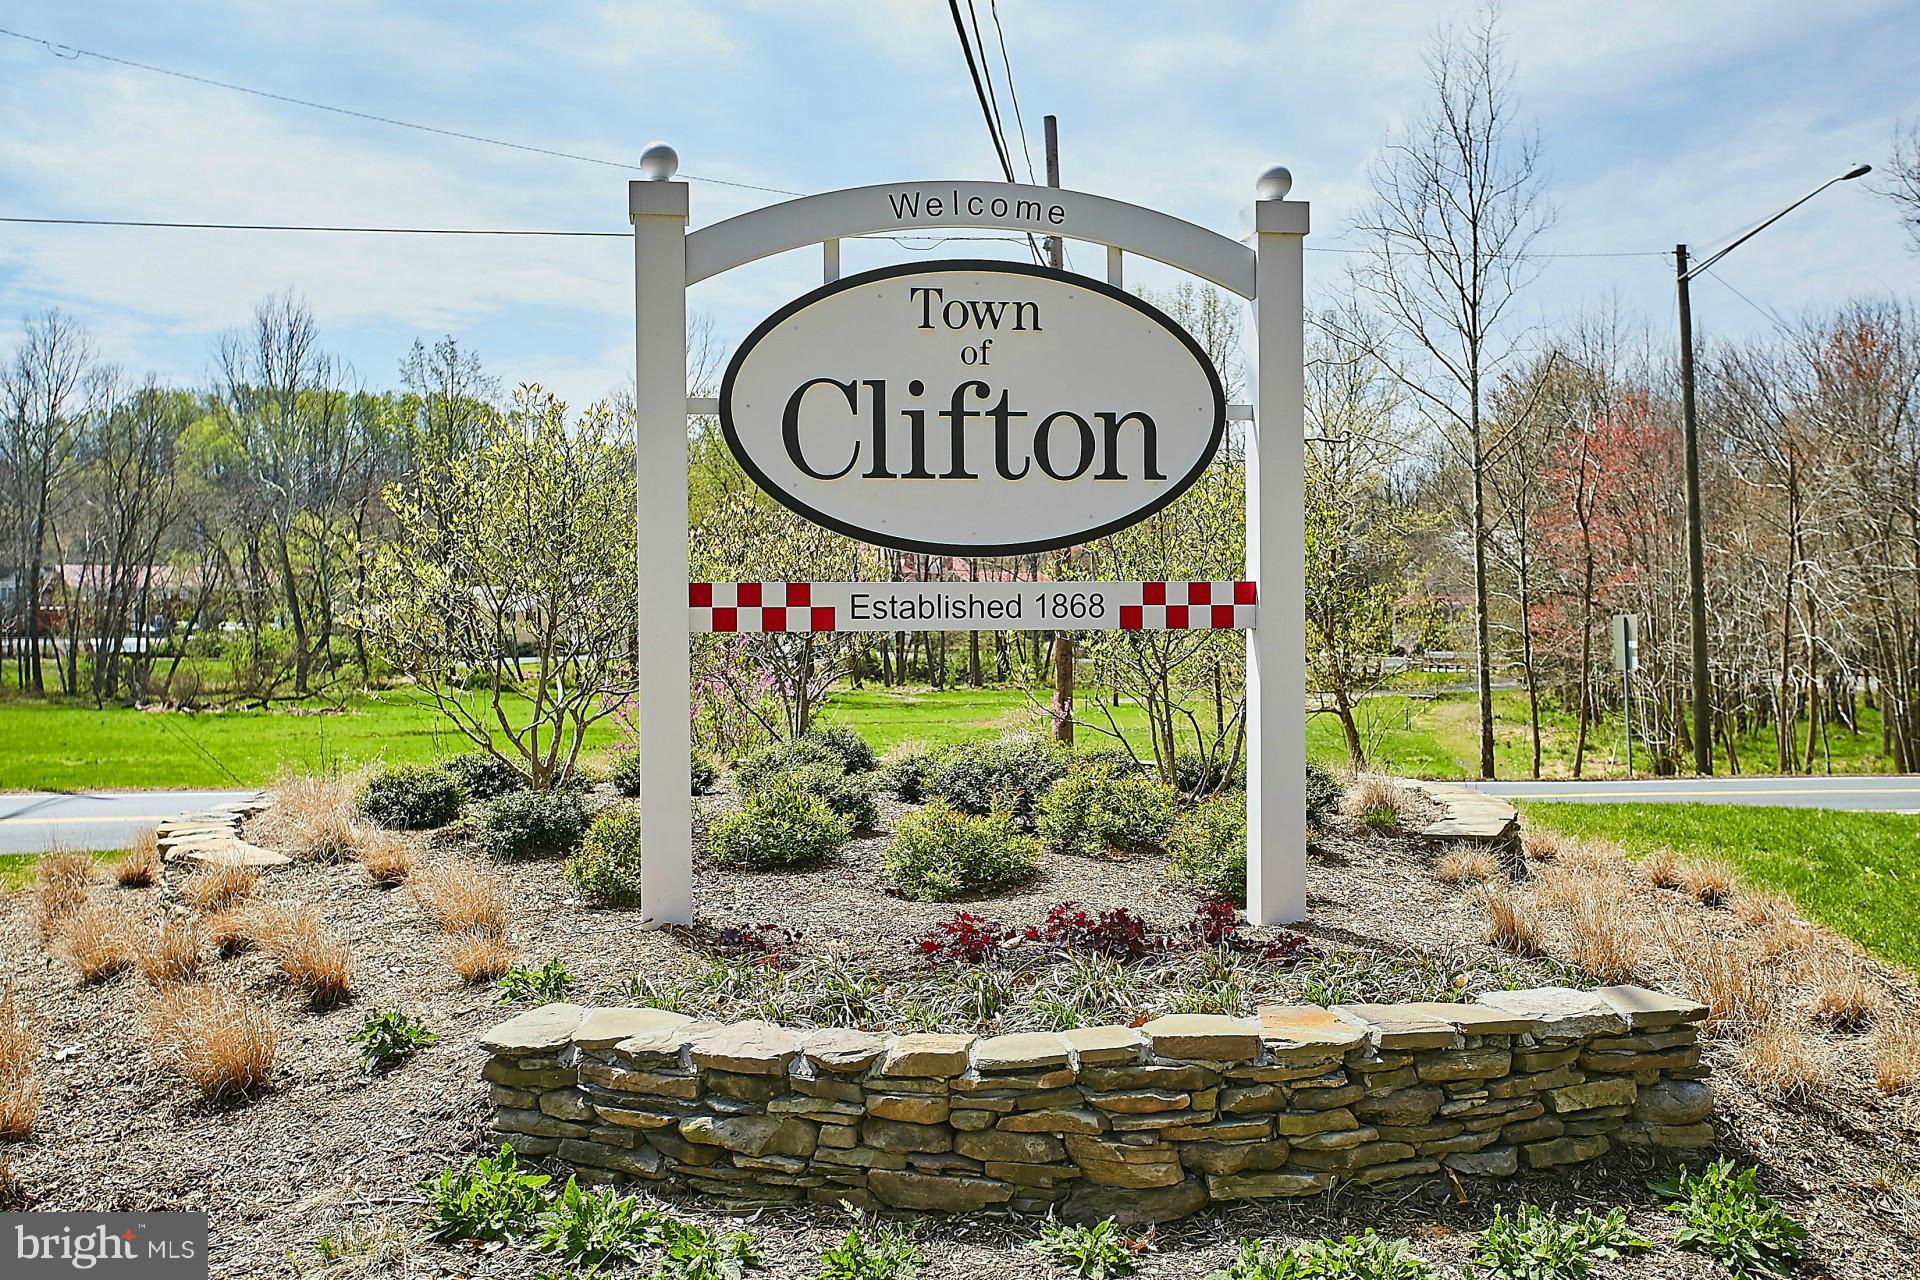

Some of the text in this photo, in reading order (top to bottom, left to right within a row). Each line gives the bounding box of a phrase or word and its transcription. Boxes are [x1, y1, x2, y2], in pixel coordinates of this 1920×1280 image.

[889, 190, 1066, 225] Welcome
[911, 288, 1042, 331] Town
[961, 339, 992, 365] of
[782, 378, 1167, 481] Clifton
[850, 593, 1105, 620] Established 1868
